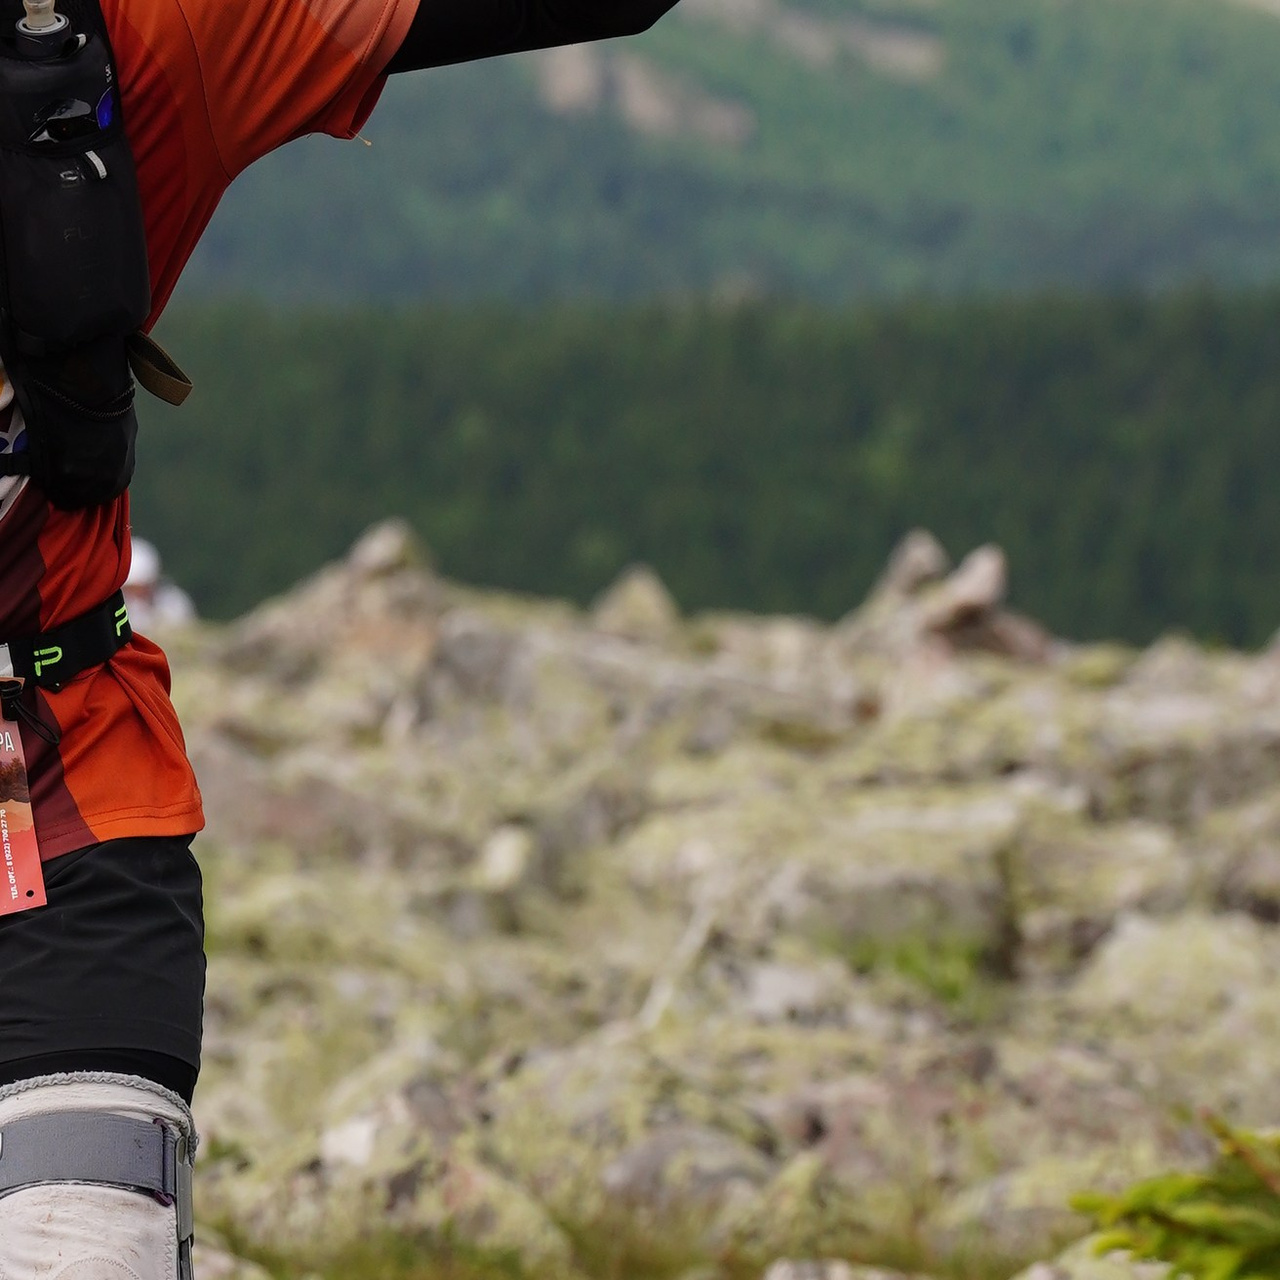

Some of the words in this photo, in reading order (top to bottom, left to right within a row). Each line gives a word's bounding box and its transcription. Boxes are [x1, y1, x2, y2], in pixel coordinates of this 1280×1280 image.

[0, 809, 6, 818] 70
[1, 820, 7, 828] 27
[4, 843, 12, 861] (922)
